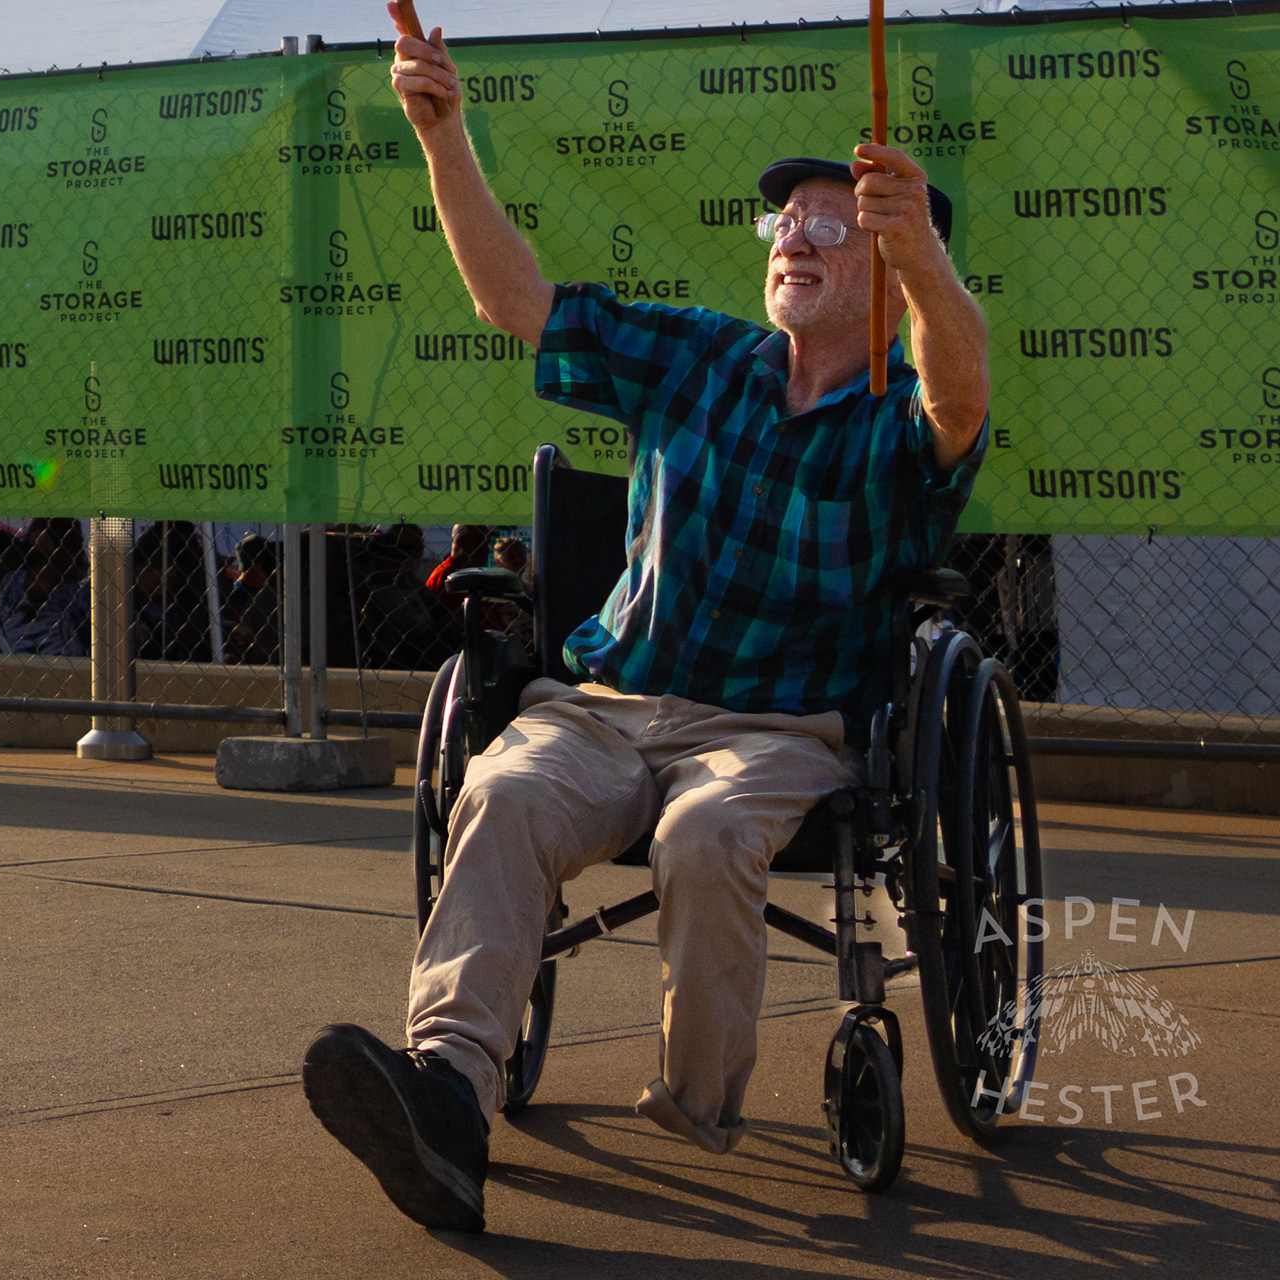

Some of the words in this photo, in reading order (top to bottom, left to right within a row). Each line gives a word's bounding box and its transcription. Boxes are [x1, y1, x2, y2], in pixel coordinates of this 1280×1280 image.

[1009, 49, 1160, 79] WATSON'S
[701, 63, 836, 94] WATSON'S
[160, 88, 263, 119] WATSON'S
[1231, 105, 1260, 115] THE
[323, 132, 351, 140] THE
[604, 122, 633, 132] THE
[859, 121, 996, 146] SORAGE
[1186, 116, 1280, 136] STORA
[280, 142, 399, 162] STORAGE
[557, 133, 685, 154] STORAGE
[1218, 138, 1280, 151] PROJEC
[47, 156, 145, 179] STORAGE
[302, 164, 372, 175] PROJECT
[583, 156, 655, 167] PROJECT
[1015, 187, 1166, 218] WATSON'S
[152, 212, 262, 240] WATSON'S
[79, 280, 101, 289] THE
[281, 284, 400, 303] STORAGE
[41, 291, 142, 310] STORAGE
[61, 312, 119, 322] PROJECT
[154, 337, 264, 364] WATSON'S
[1020, 328, 1171, 358] WATSON'S
[46, 428, 146, 445] STORAGE
[283, 427, 402, 444] STORAGE
[160, 464, 267, 489] WATSON'S
[417, 464, 532, 492] WATSON'
[1029, 469, 1179, 499] WATSON'S
